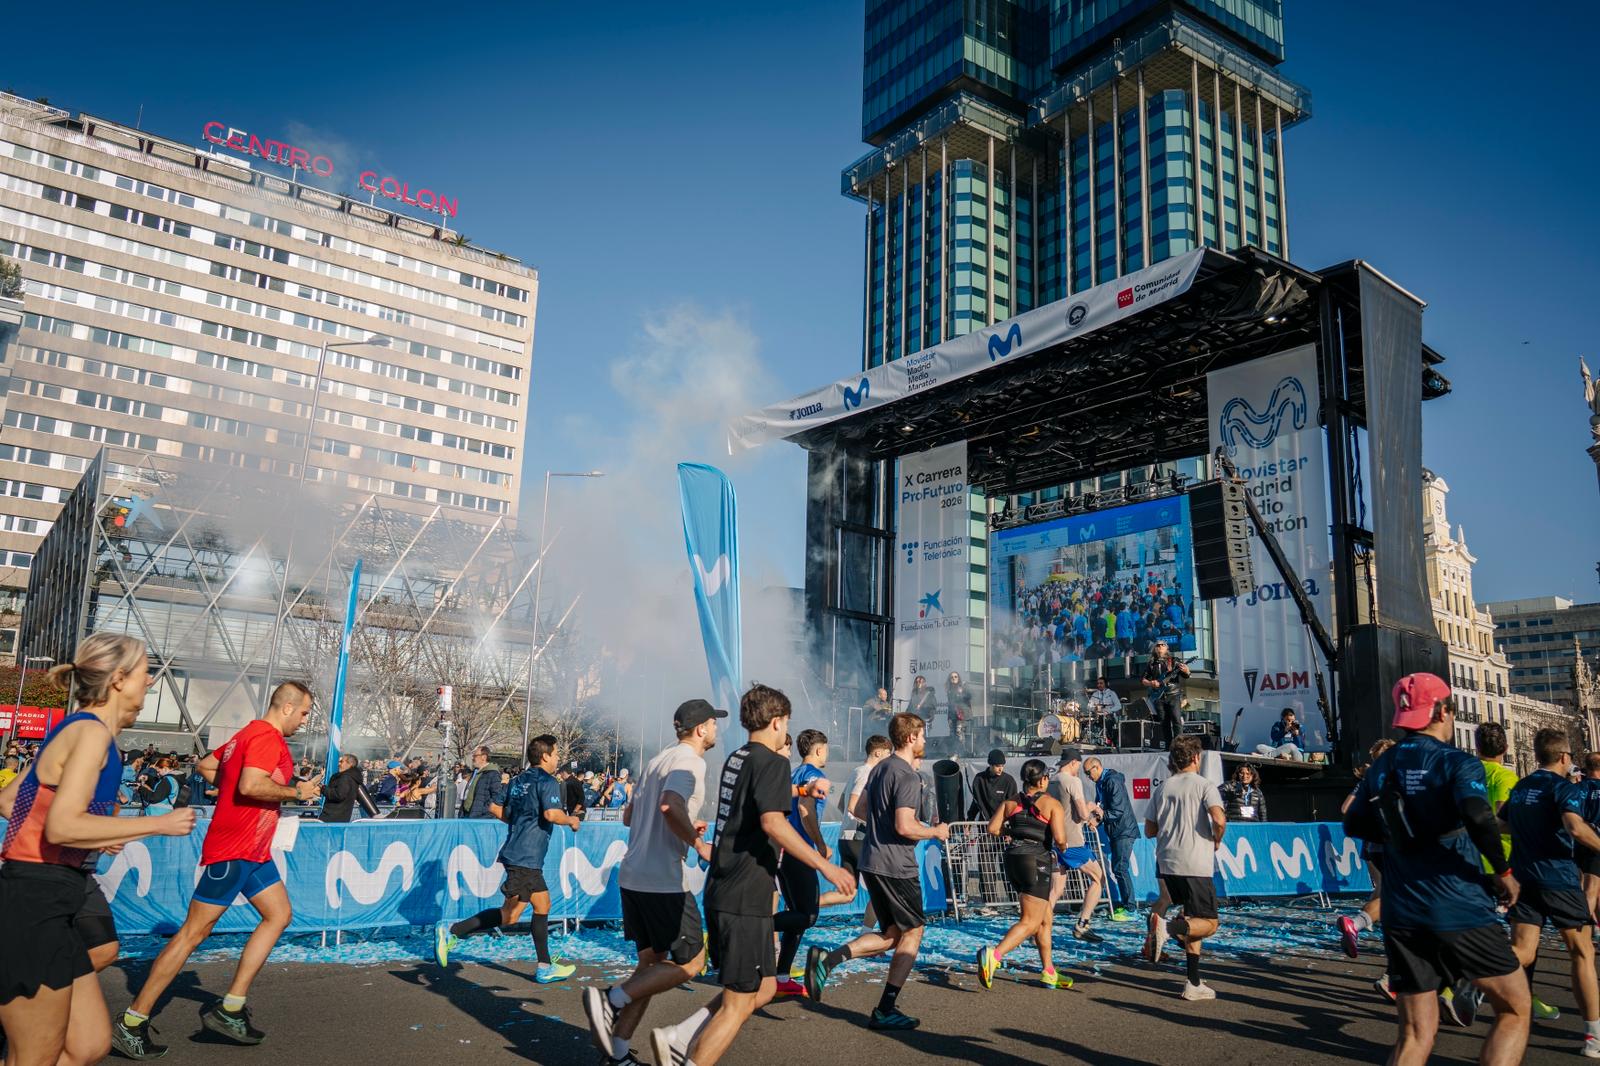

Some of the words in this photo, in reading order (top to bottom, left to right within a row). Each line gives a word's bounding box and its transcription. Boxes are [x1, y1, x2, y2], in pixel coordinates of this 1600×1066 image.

[203, 121, 334, 177] CENTRO
[359, 171, 458, 218] COLON
[1134, 270, 1181, 293] Comunidad
[1135, 294, 1147, 303] de
[1148, 277, 1179, 297] Madrid
[907, 352, 936, 367] Movistar
[907, 362, 931, 376] Madrid
[908, 372, 929, 384] Medio
[905, 474, 913, 487] X
[917, 466, 962, 484] Carrera
[902, 482, 963, 504] ProFuturo
[941, 496, 963, 508] 2026
[923, 536, 963, 550] Fundación
[923, 547, 962, 561] Telefónica
[901, 621, 934, 631] Fundación
[919, 660, 951, 671] MADRID
[1260, 671, 1309, 691] ADM
